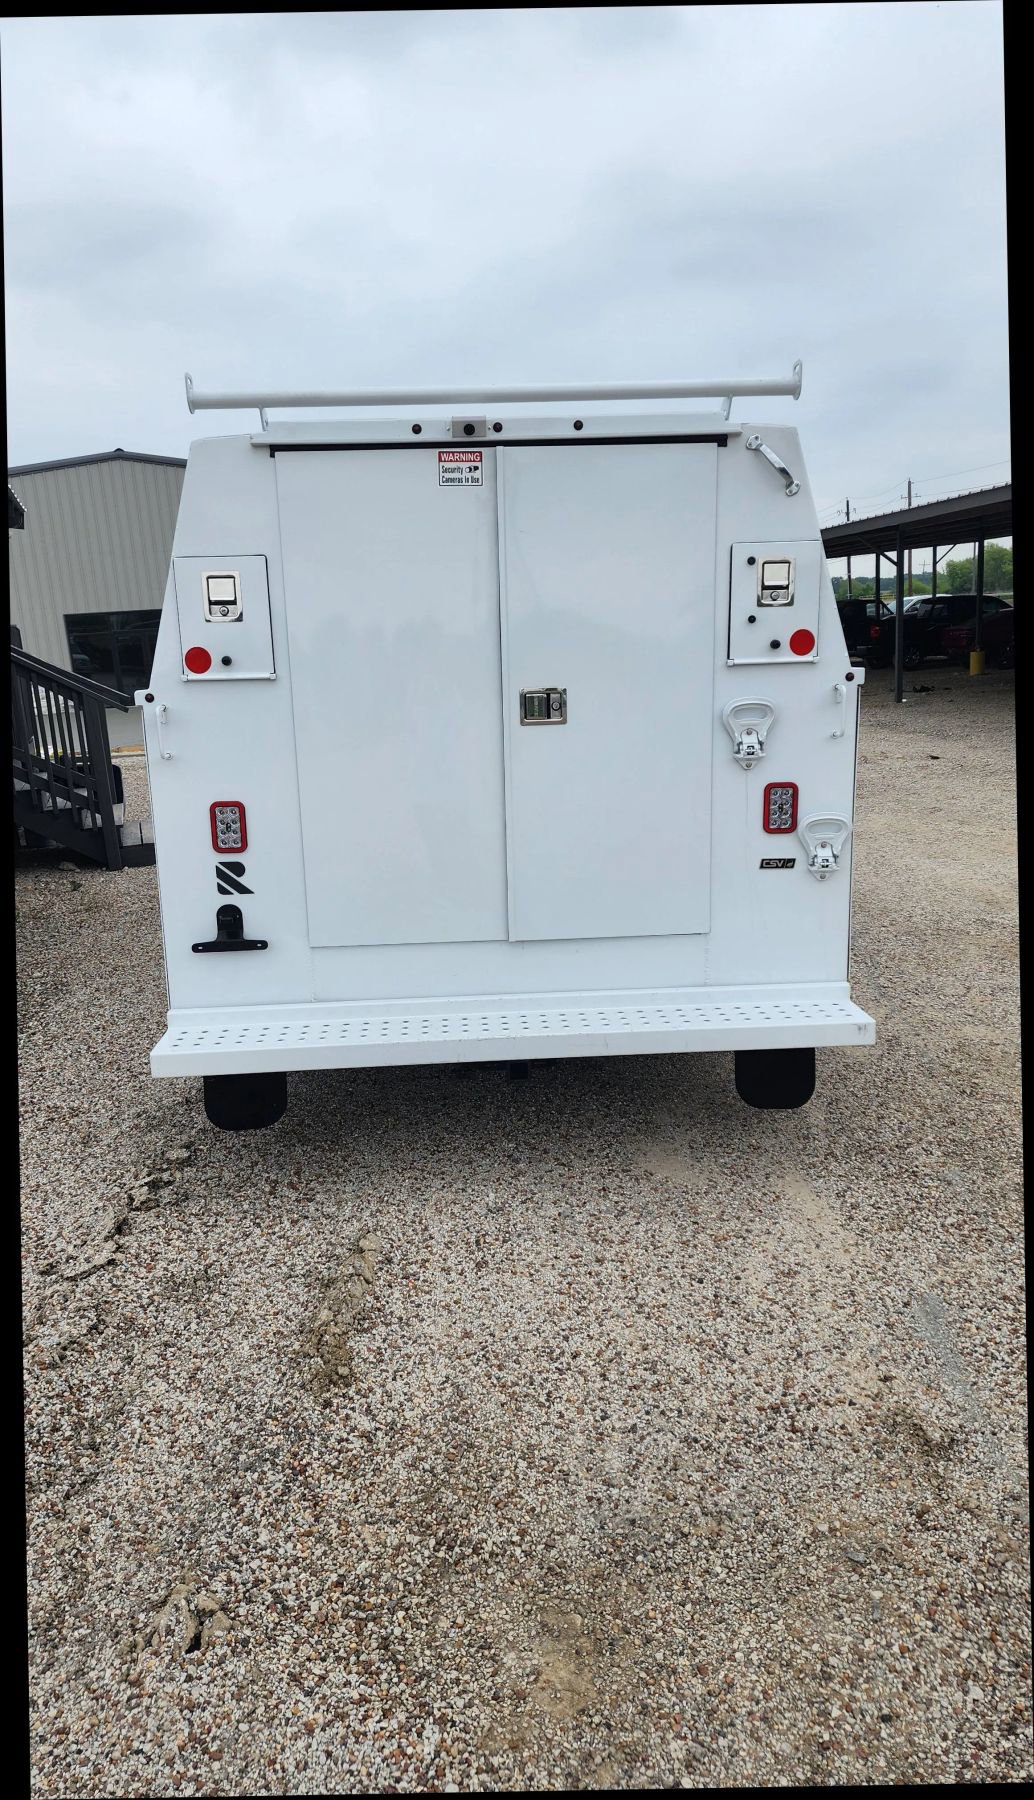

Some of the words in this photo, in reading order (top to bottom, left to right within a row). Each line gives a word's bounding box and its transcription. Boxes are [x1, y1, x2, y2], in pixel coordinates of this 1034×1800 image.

[440, 452, 481, 462] WARNING
[441, 465, 464, 475] Security
[441, 475, 464, 484] Cameras
[470, 475, 480, 484] Use
[762, 860, 785, 868] CSV
